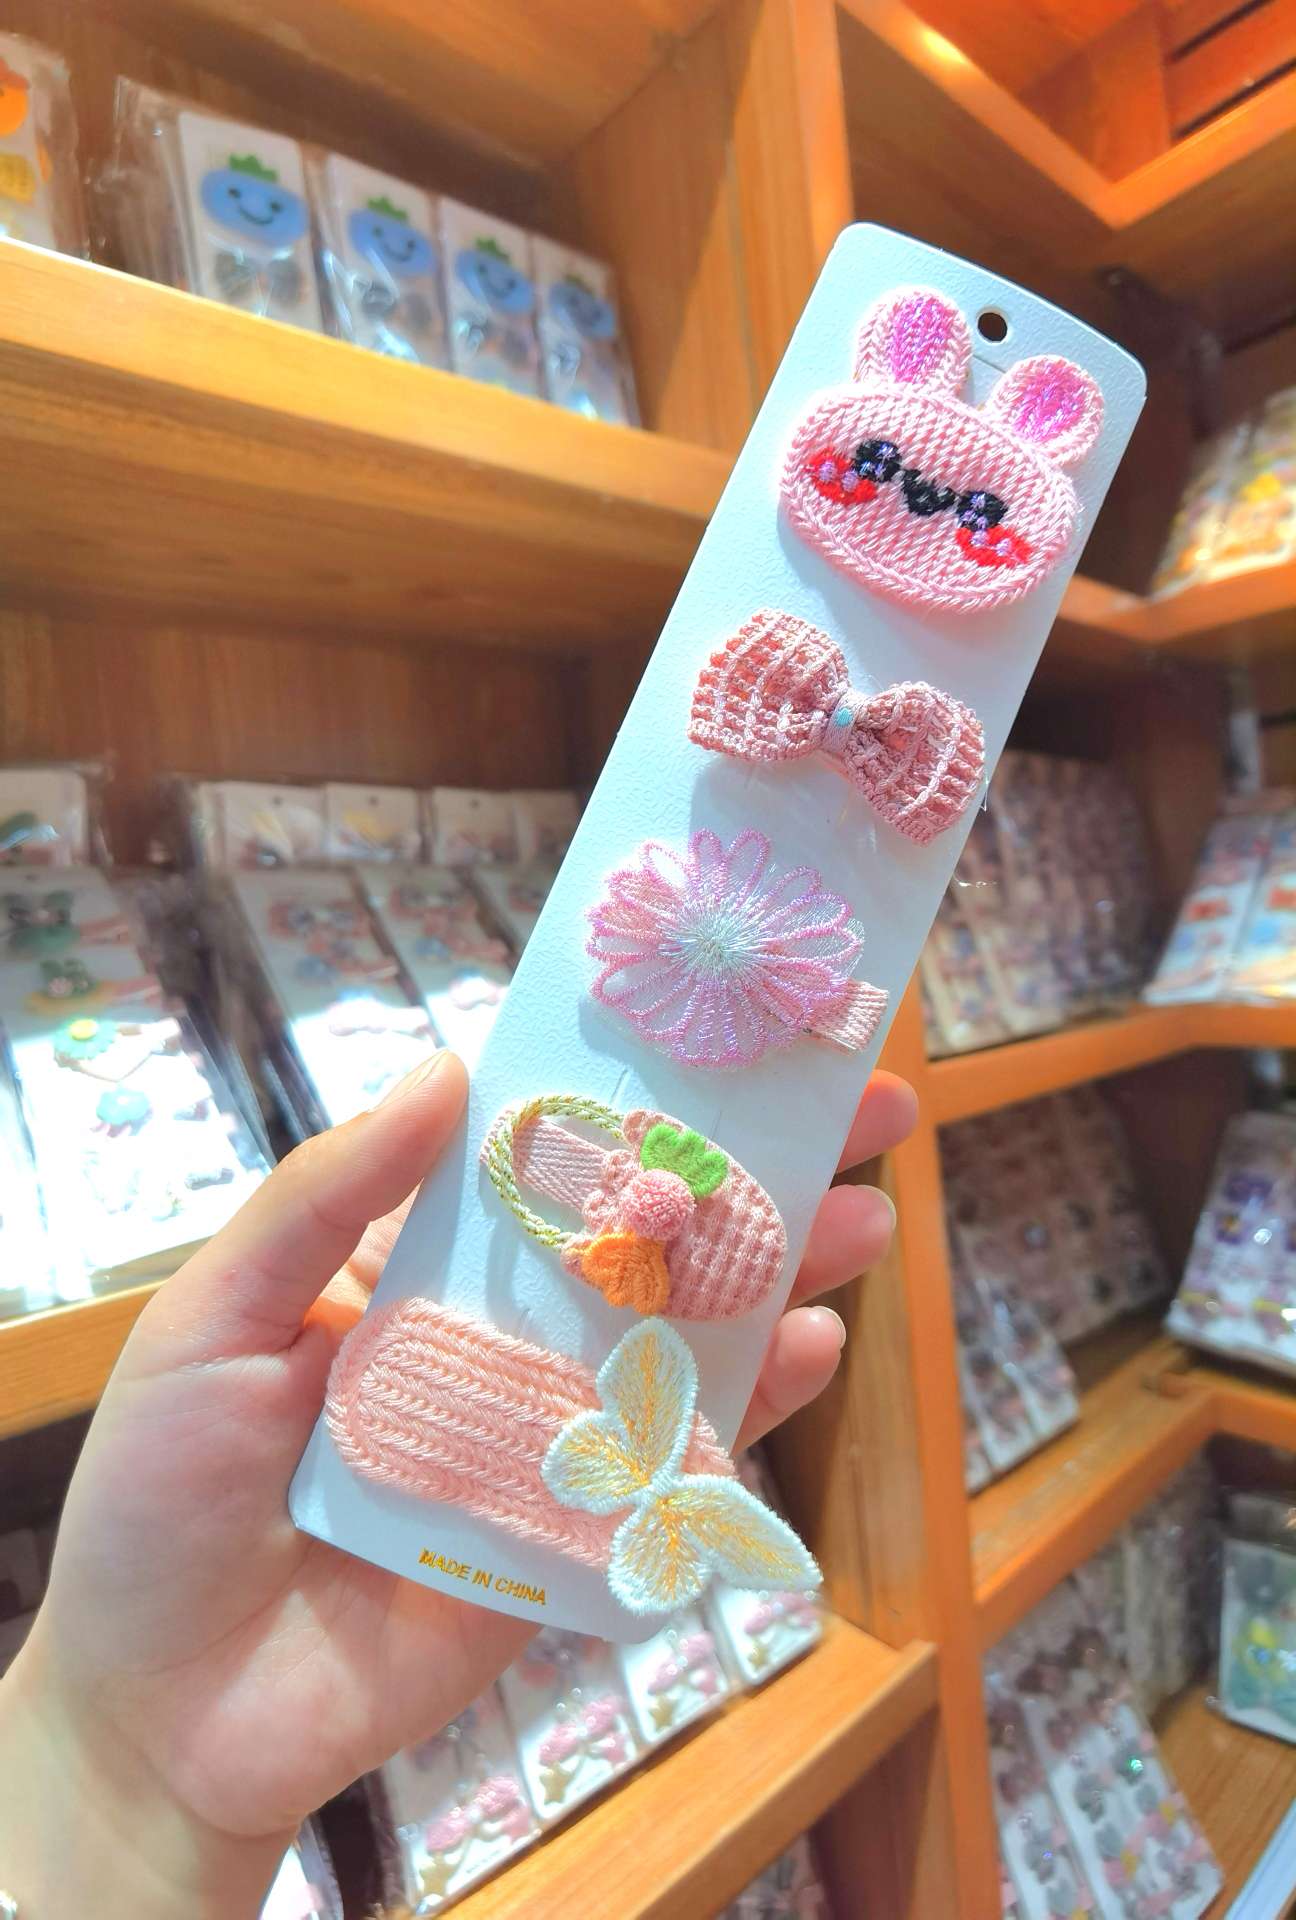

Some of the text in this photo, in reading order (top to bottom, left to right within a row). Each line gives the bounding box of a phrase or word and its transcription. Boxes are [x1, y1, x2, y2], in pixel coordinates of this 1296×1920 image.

[418, 1548, 546, 1605] MADE IN CHINA
